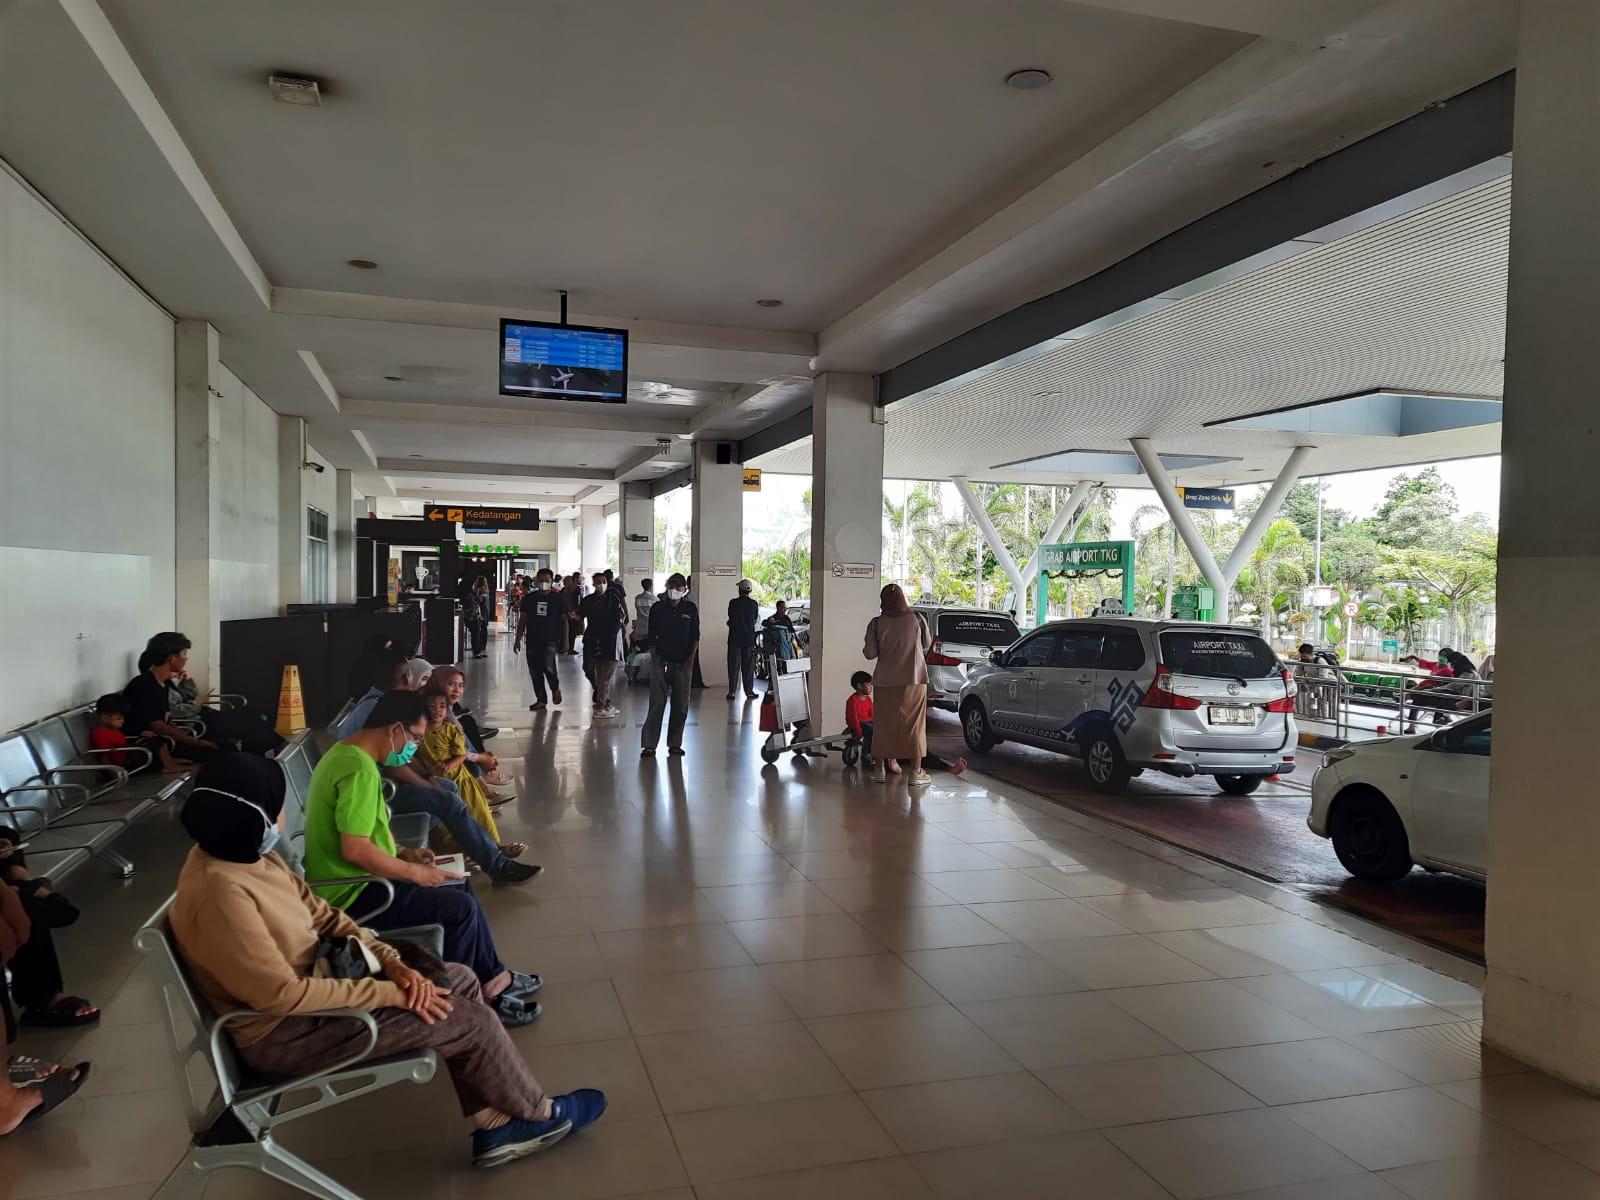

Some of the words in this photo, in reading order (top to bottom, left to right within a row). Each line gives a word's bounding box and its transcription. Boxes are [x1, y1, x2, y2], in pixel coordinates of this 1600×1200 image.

[466, 510, 521, 521] Kedatangan
[485, 544, 520, 554] CAFE
[1045, 551, 1064, 563] GRAB
[1065, 549, 1098, 563] AIRPORT
[1101, 548, 1118, 561] TKG
[1193, 640, 1226, 650] AIRPORT
[1227, 641, 1246, 651] TAXI
